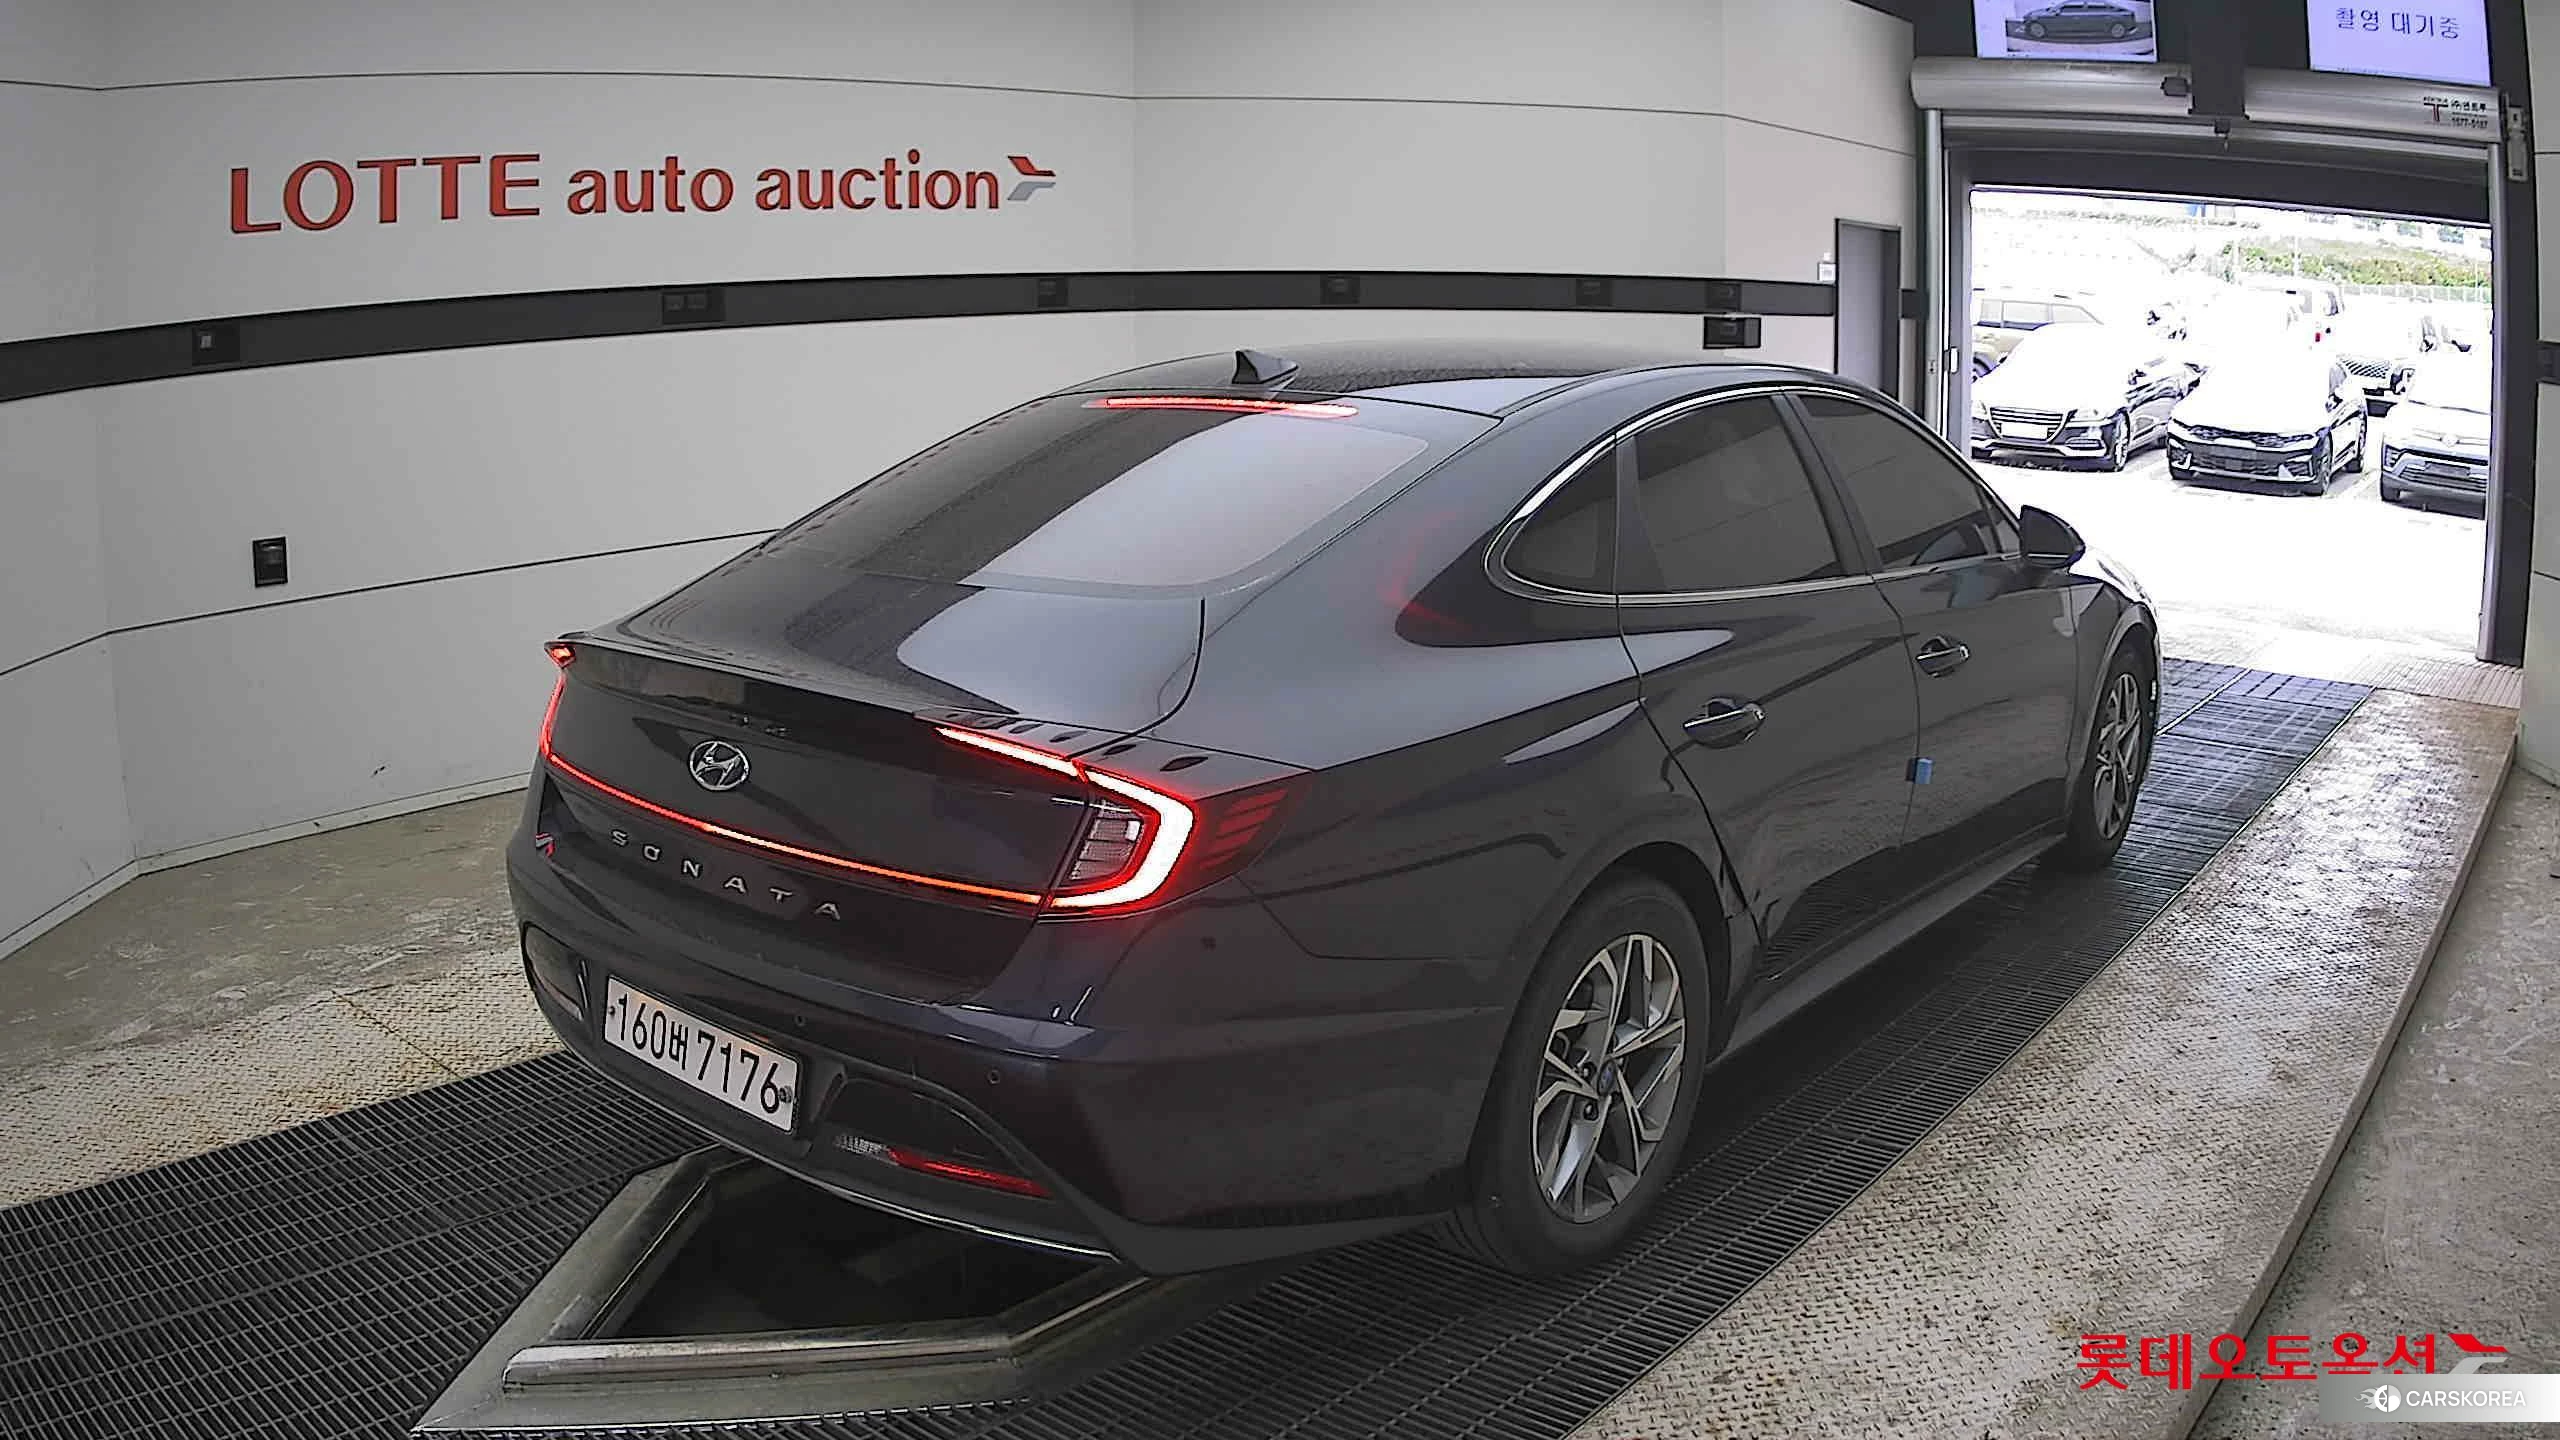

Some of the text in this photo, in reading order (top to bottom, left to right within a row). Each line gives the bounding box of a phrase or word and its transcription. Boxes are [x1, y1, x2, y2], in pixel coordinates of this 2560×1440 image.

[2336, 8, 2459, 39] 촬영 대기중
[229, 148, 1000, 234] LOTTE auto auction
[611, 829, 841, 920] SONATA
